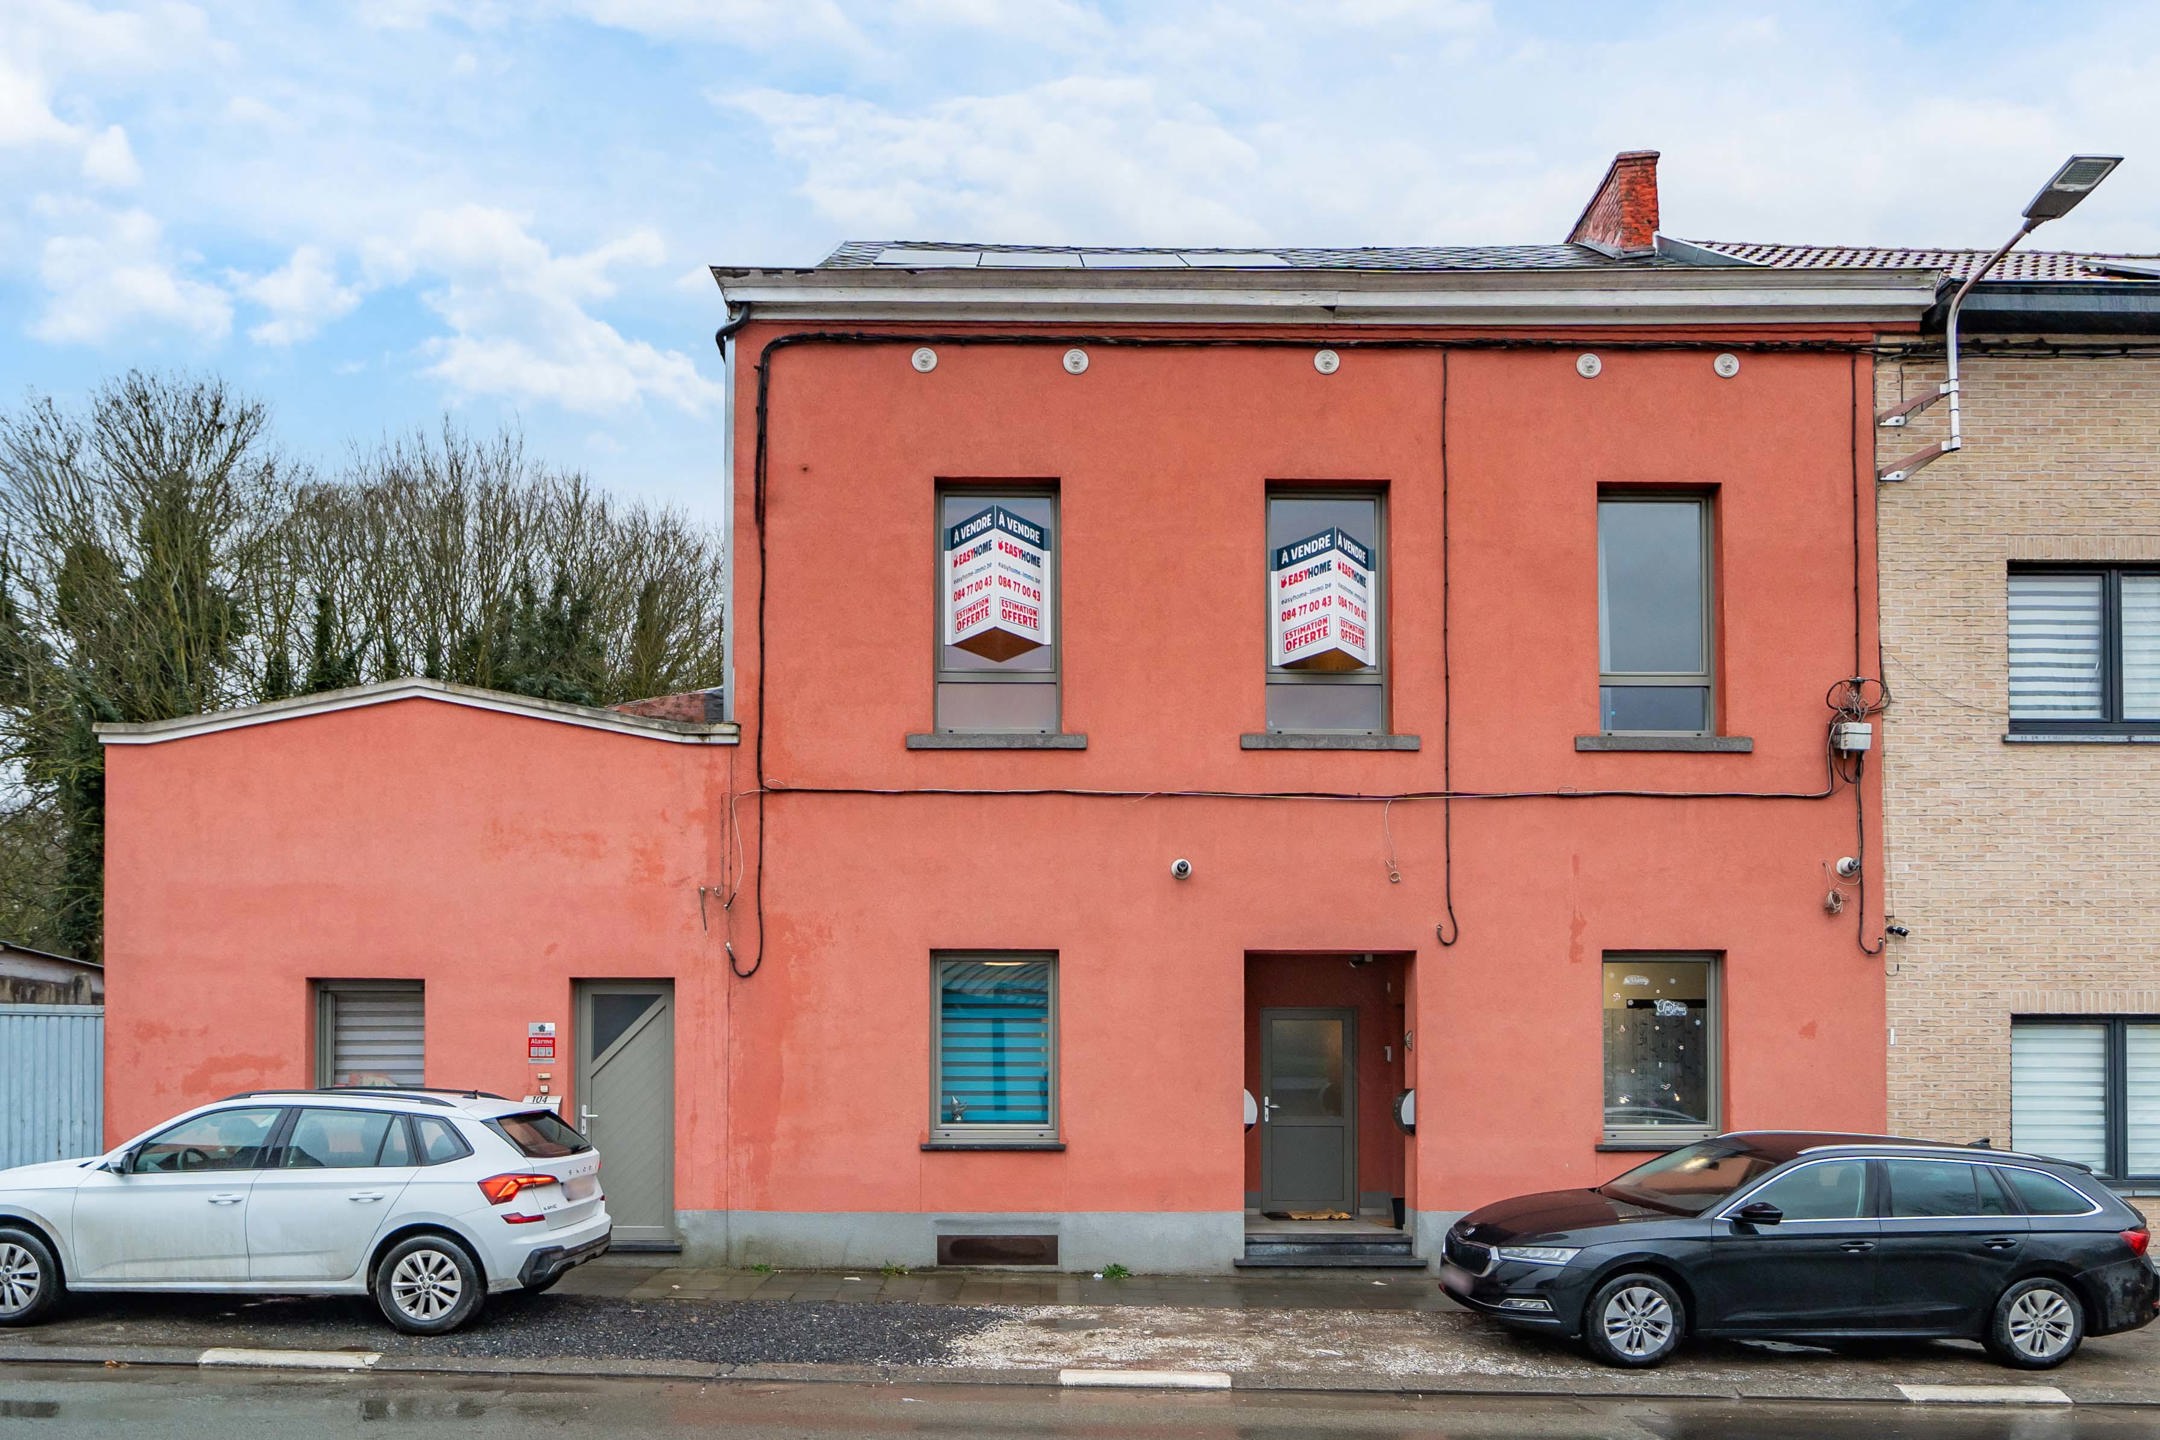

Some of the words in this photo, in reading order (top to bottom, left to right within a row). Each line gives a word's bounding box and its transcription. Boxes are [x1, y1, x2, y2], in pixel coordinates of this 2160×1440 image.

[954, 529, 959, 543] À
[961, 513, 992, 540] VENDRE
[999, 512, 1005, 527] À
[1007, 517, 1040, 543] VENDRE
[959, 539, 992, 565] EASYHOME
[1005, 542, 1041, 568] EASYHOME
[1281, 549, 1289, 565] À
[1291, 534, 1331, 560] VENDRE
[1338, 532, 1342, 546] À
[1343, 537, 1366, 563] VENDRE
[1288, 560, 1332, 585] EASYHOME
[1342, 560, 1366, 588] EASYHOME
[954, 587, 965, 602] 084
[967, 584, 973, 596] 77
[975, 580, 983, 592] 00
[984, 575, 992, 588] 43
[998, 575, 1012, 589] 084
[1013, 581, 1021, 592] 77
[1022, 585, 1031, 598] 00
[1032, 590, 1040, 602] 43
[956, 597, 989, 620] ESTIMATION
[1001, 599, 1038, 617] ESTIMATION
[1282, 609, 1296, 622] 084
[1298, 604, 1307, 617] 77
[1309, 600, 1318, 613] 00
[1322, 596, 1332, 607] 43
[1338, 595, 1347, 609] 084
[957, 607, 989, 631] OFFERTE
[1002, 608, 1038, 628] OFFERTE
[1285, 617, 1328, 640] ESTIMATION
[1286, 626, 1328, 651] OFFERTE
[1341, 628, 1365, 648] OFFERTE
